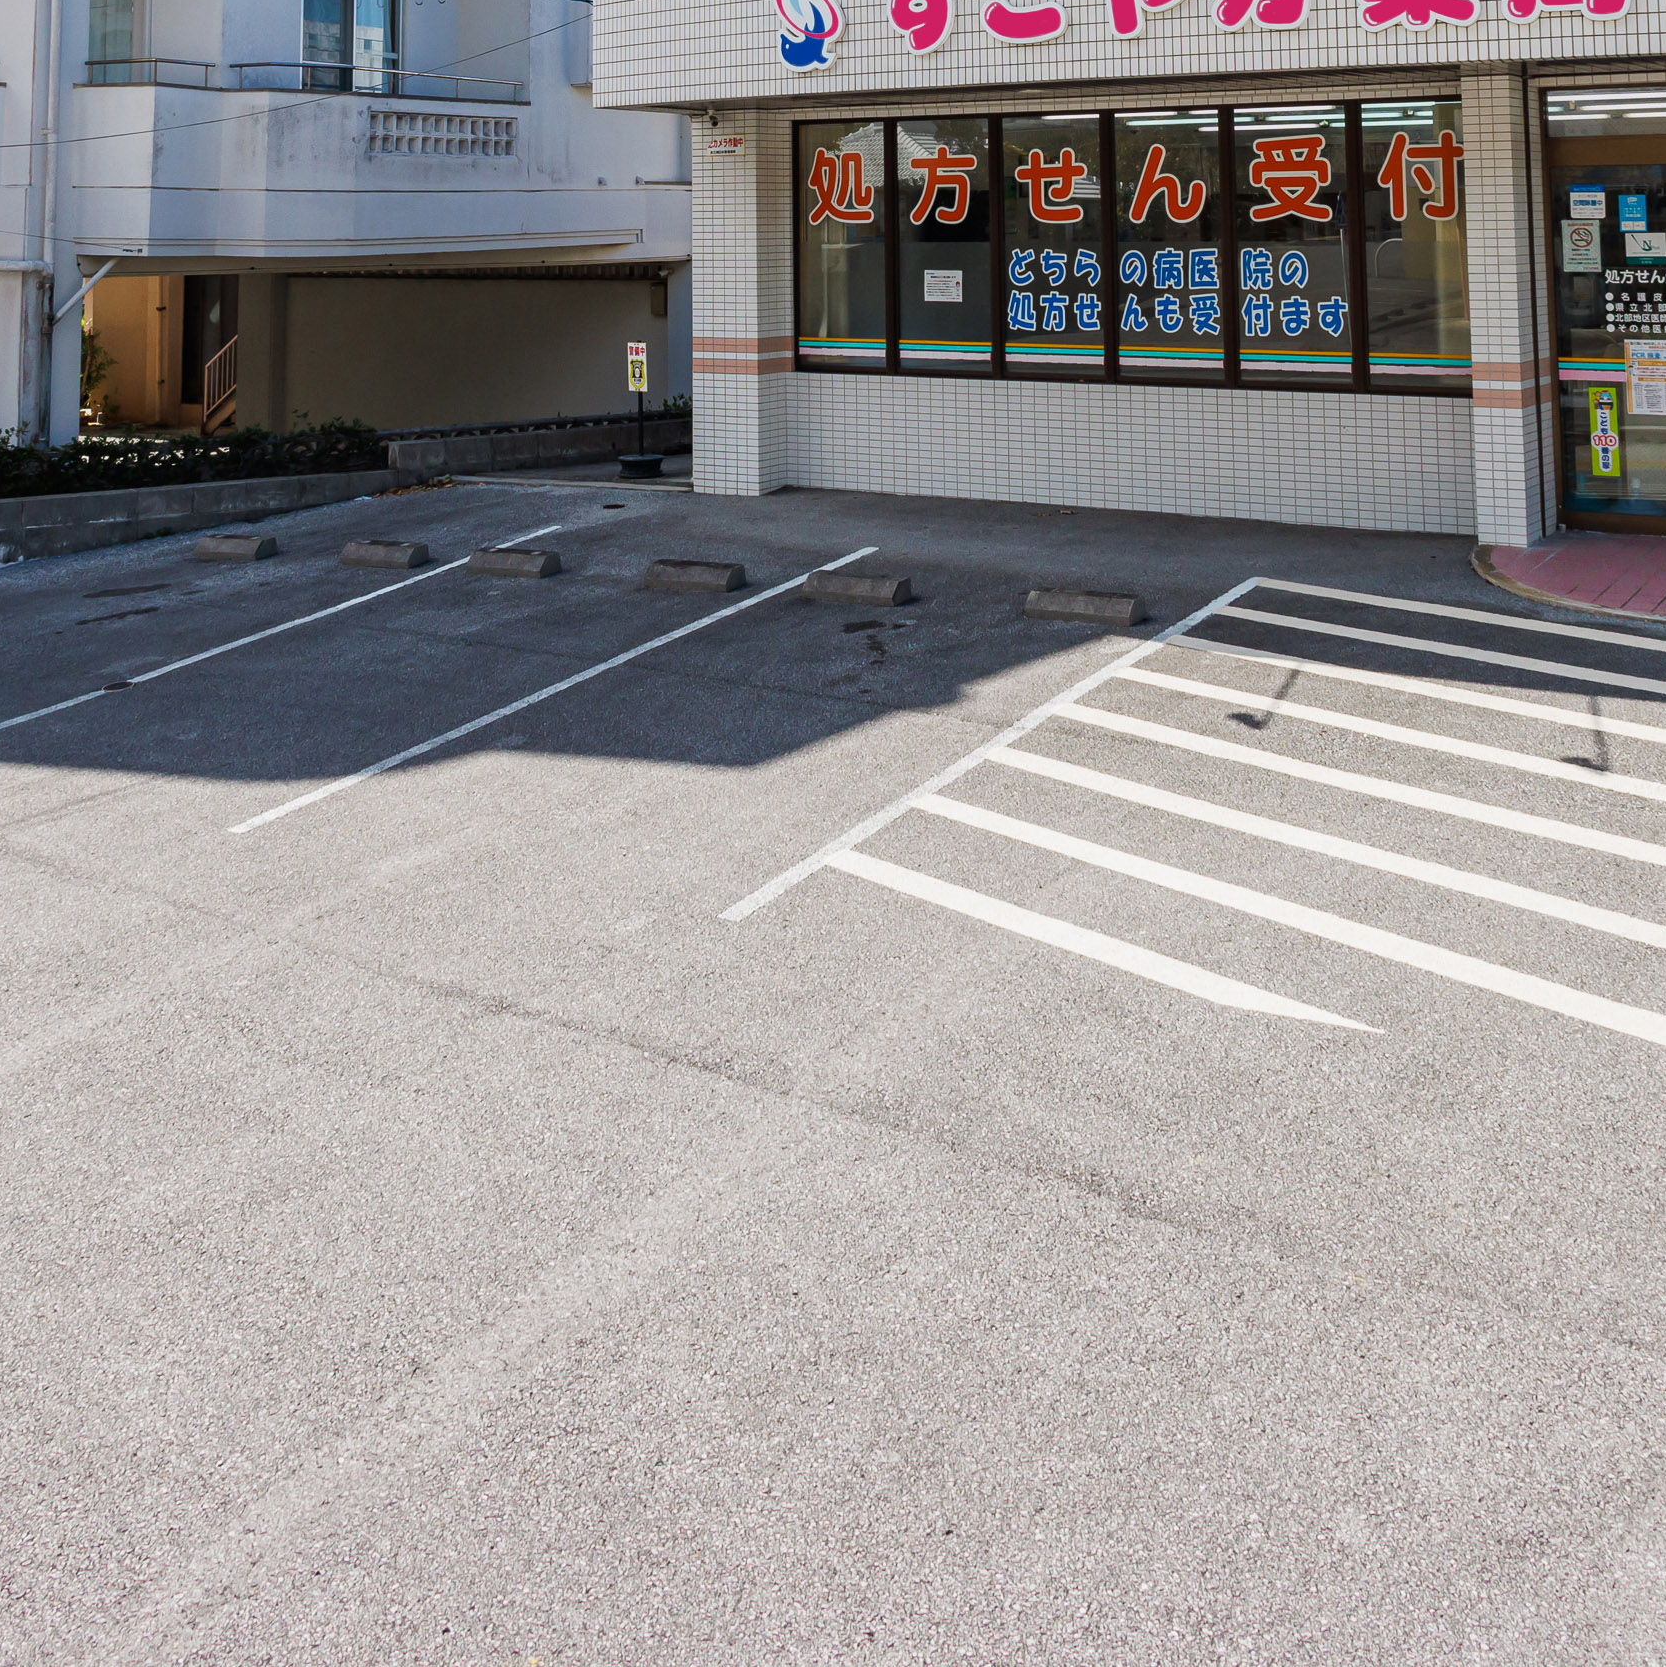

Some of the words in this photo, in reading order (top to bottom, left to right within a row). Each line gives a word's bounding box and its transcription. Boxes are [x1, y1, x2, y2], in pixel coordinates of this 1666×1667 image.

[808, 130, 1464, 225] 処方せん受付
[1008, 247, 1308, 289] どちらの病医院の
[1007, 291, 1348, 337] 処方せんも受付ます
